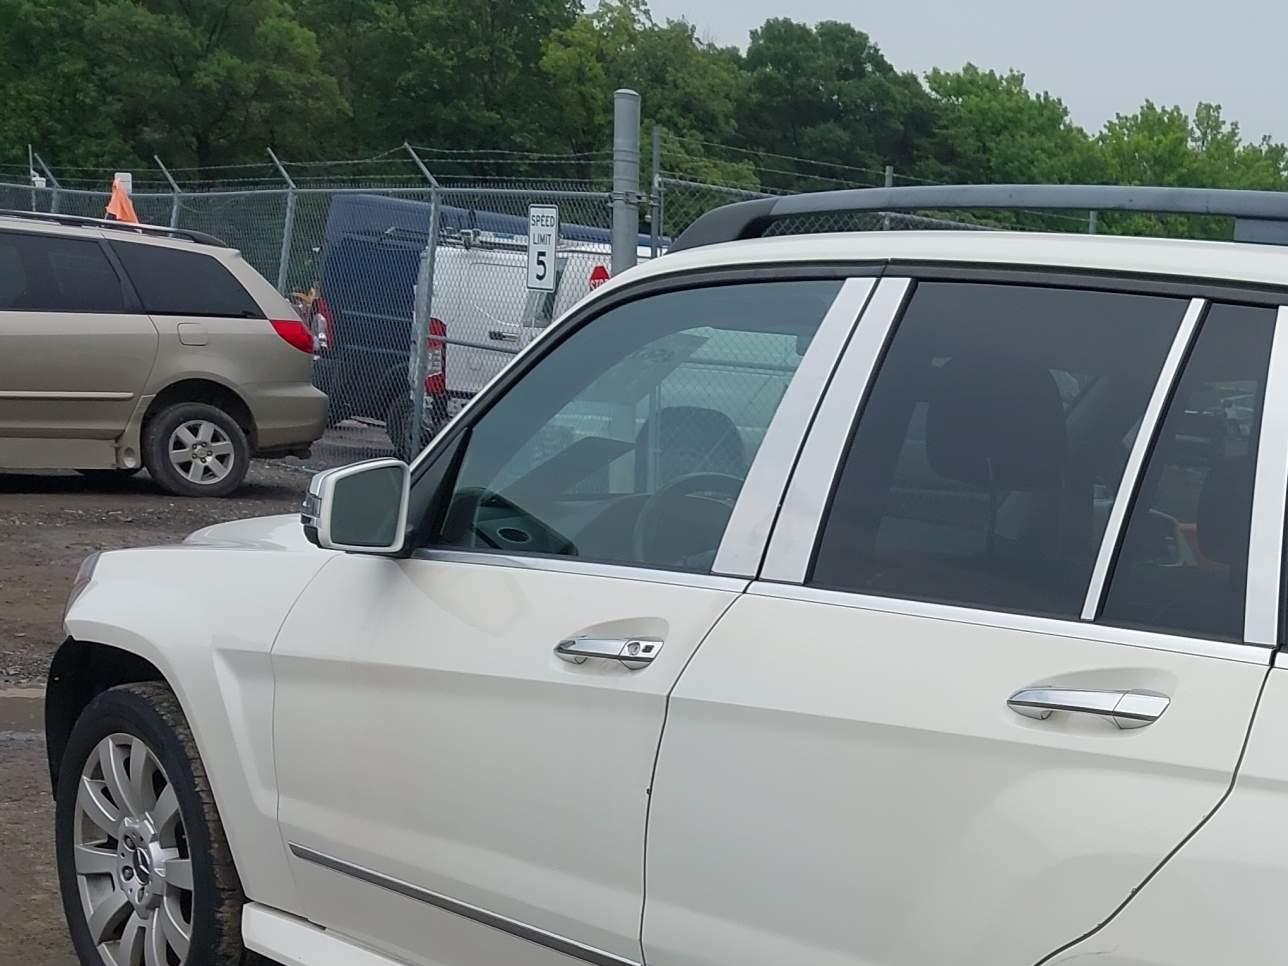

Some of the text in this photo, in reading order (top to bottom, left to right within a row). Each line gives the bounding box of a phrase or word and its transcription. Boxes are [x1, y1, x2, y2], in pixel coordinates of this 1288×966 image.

[532, 215, 555, 227] SPEED
[533, 233, 551, 245] LIMIT
[536, 251, 546, 280] 5
